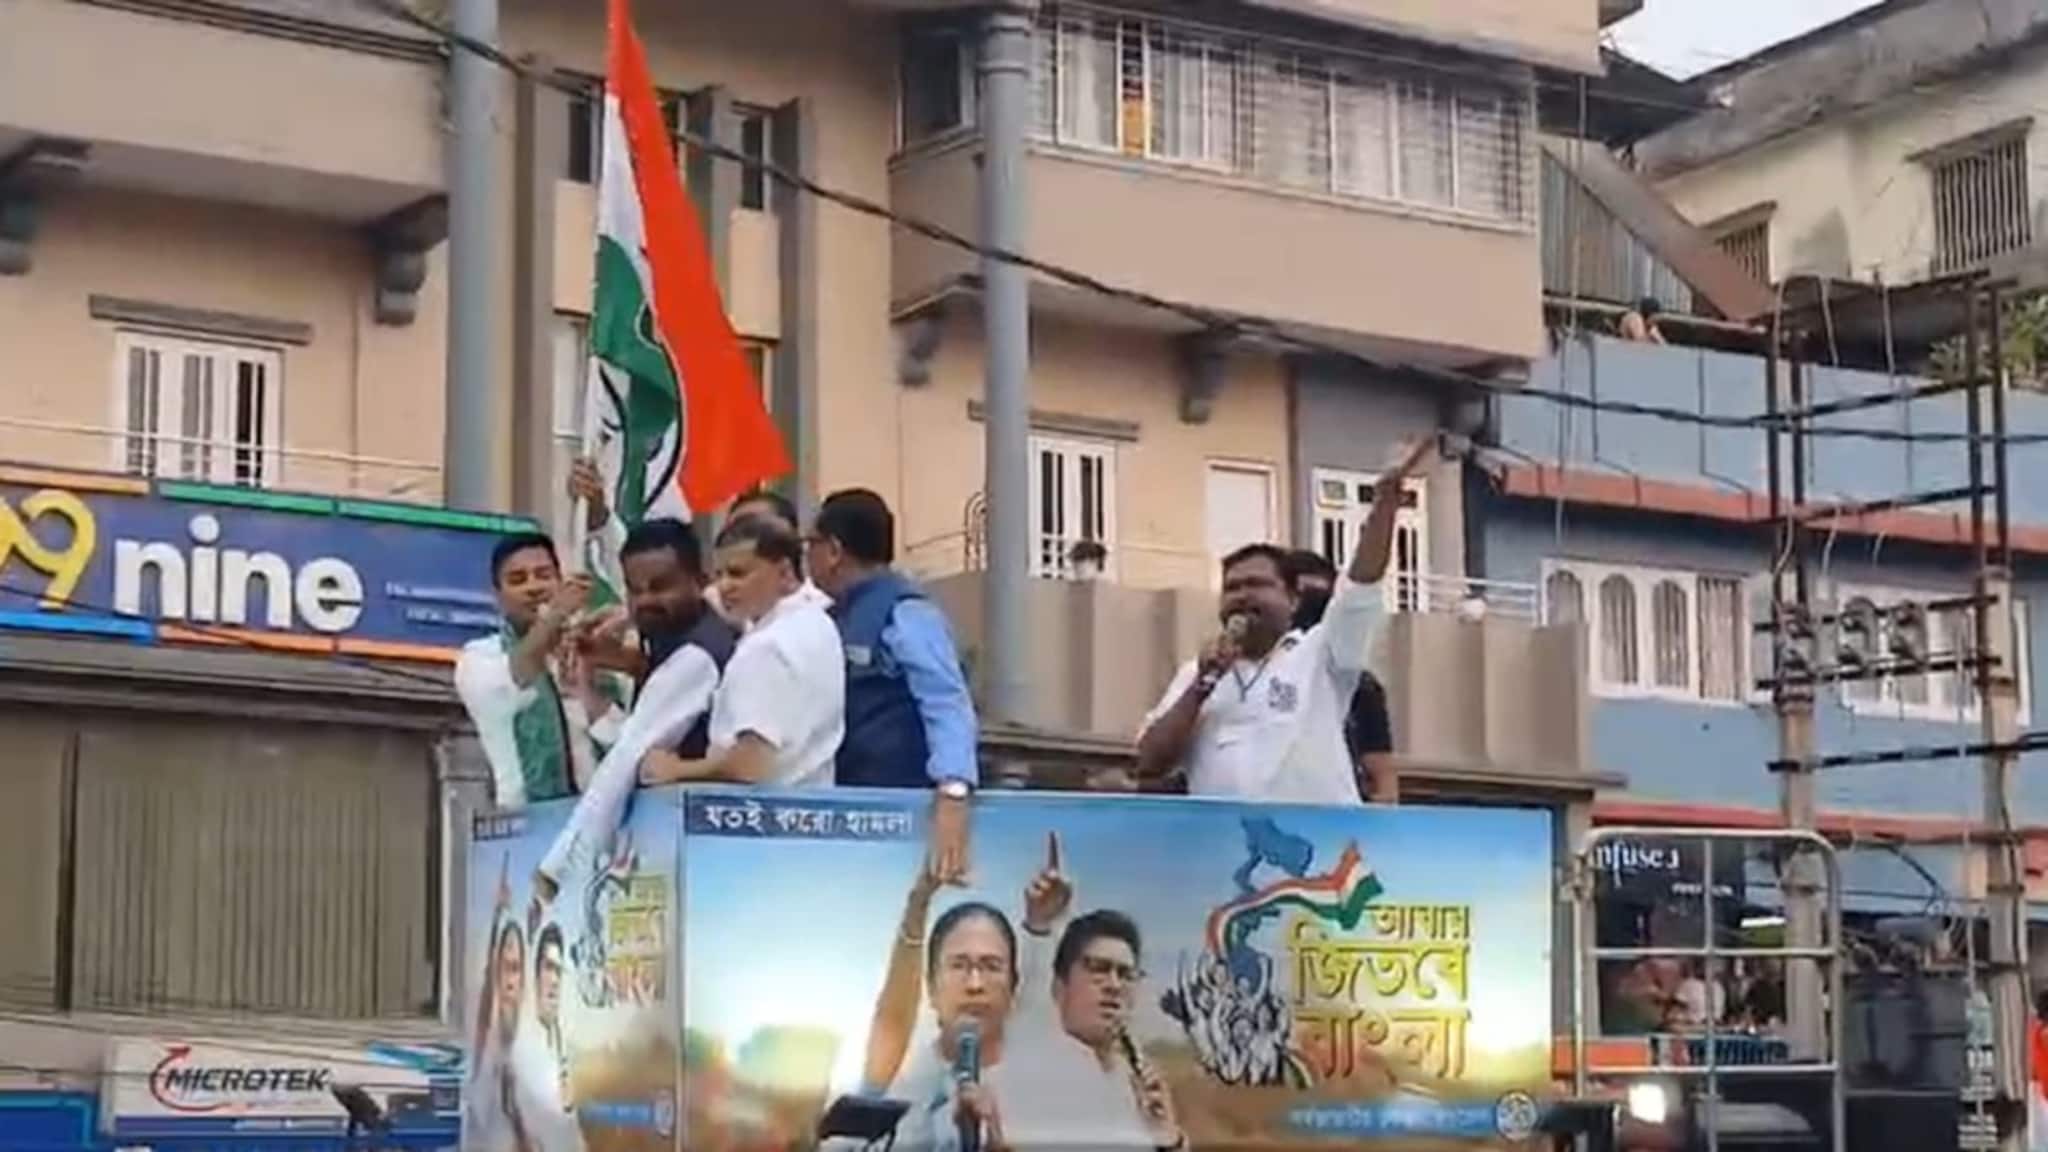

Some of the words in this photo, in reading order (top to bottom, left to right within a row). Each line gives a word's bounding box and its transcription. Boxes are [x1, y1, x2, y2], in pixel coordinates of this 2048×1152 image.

[113, 514, 363, 632] nine
[704, 801, 765, 833] যতই
[775, 807, 834, 834] করো
[845, 809, 914, 835] হামলা
[1364, 904, 1471, 941] আবার
[1289, 920, 1472, 1006] জিতবে
[1294, 1009, 1473, 1080] বাংলা
[164, 1067, 331, 1092] MICROTEK
